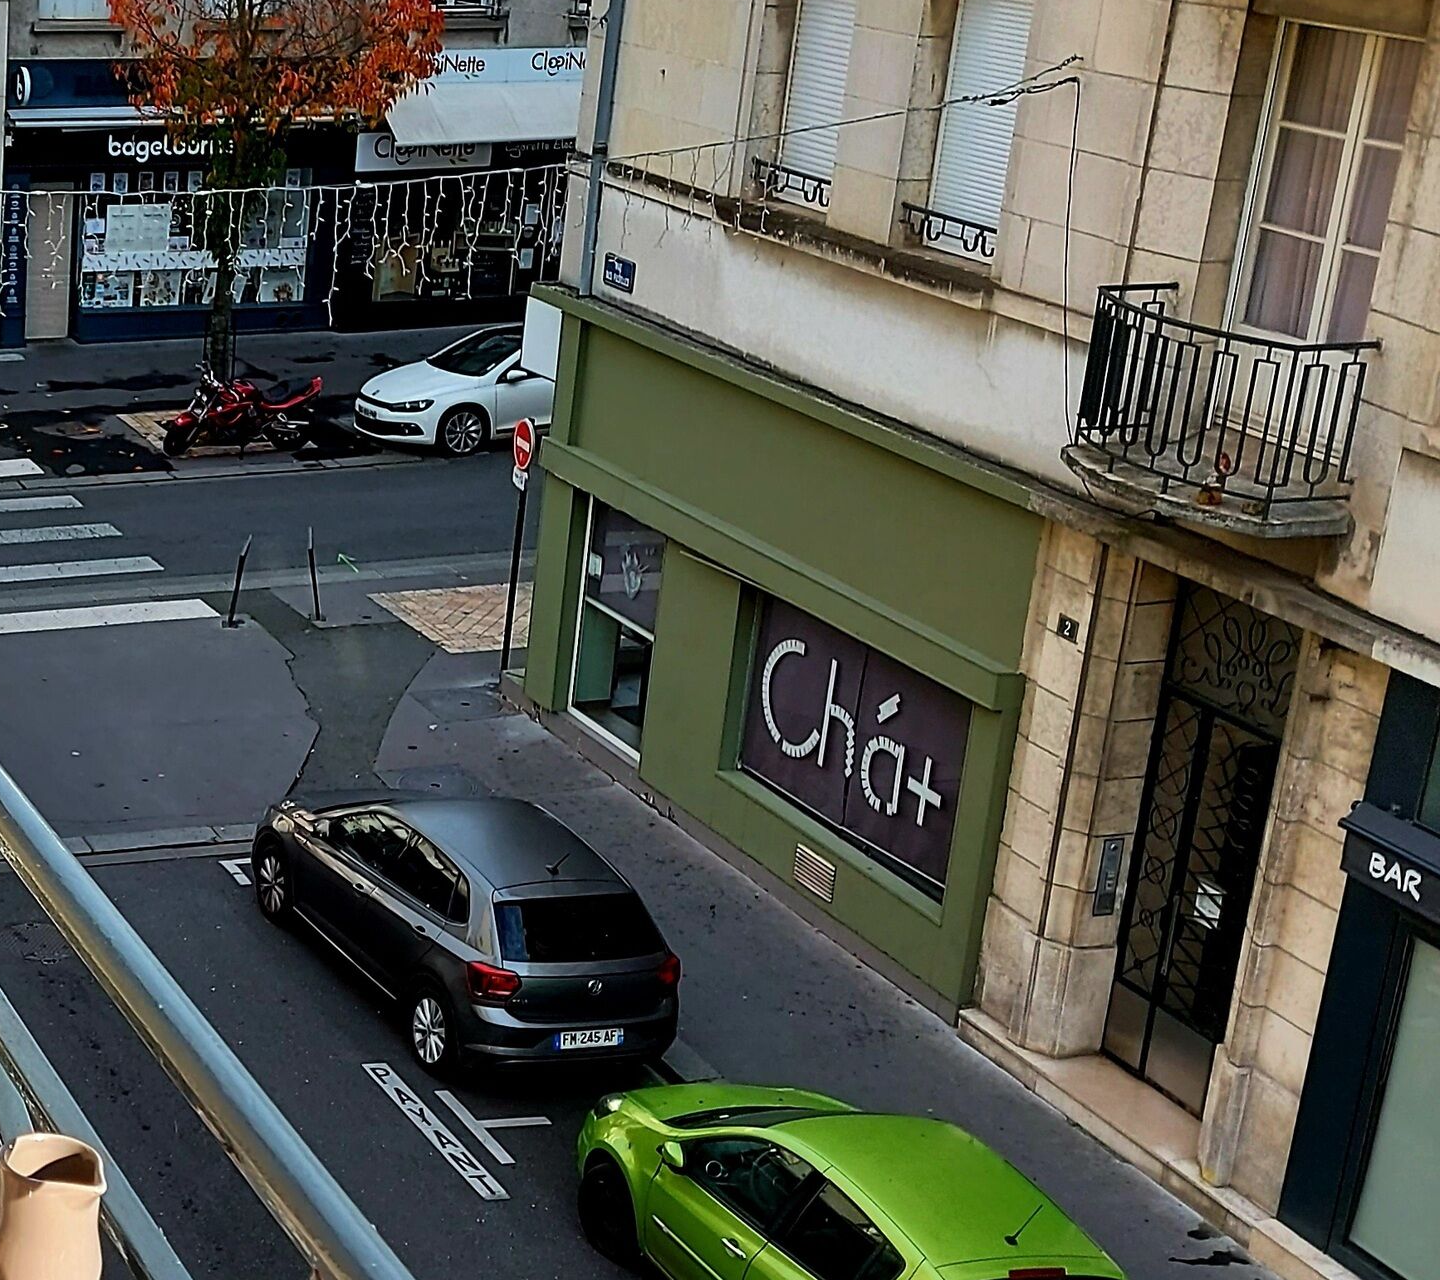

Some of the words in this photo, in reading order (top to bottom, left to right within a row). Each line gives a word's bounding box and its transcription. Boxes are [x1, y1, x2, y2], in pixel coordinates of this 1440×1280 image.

[1063, 620, 1072, 636] 2
[1369, 851, 1422, 902] BAR
[369, 1067, 496, 1195] PAYANT
